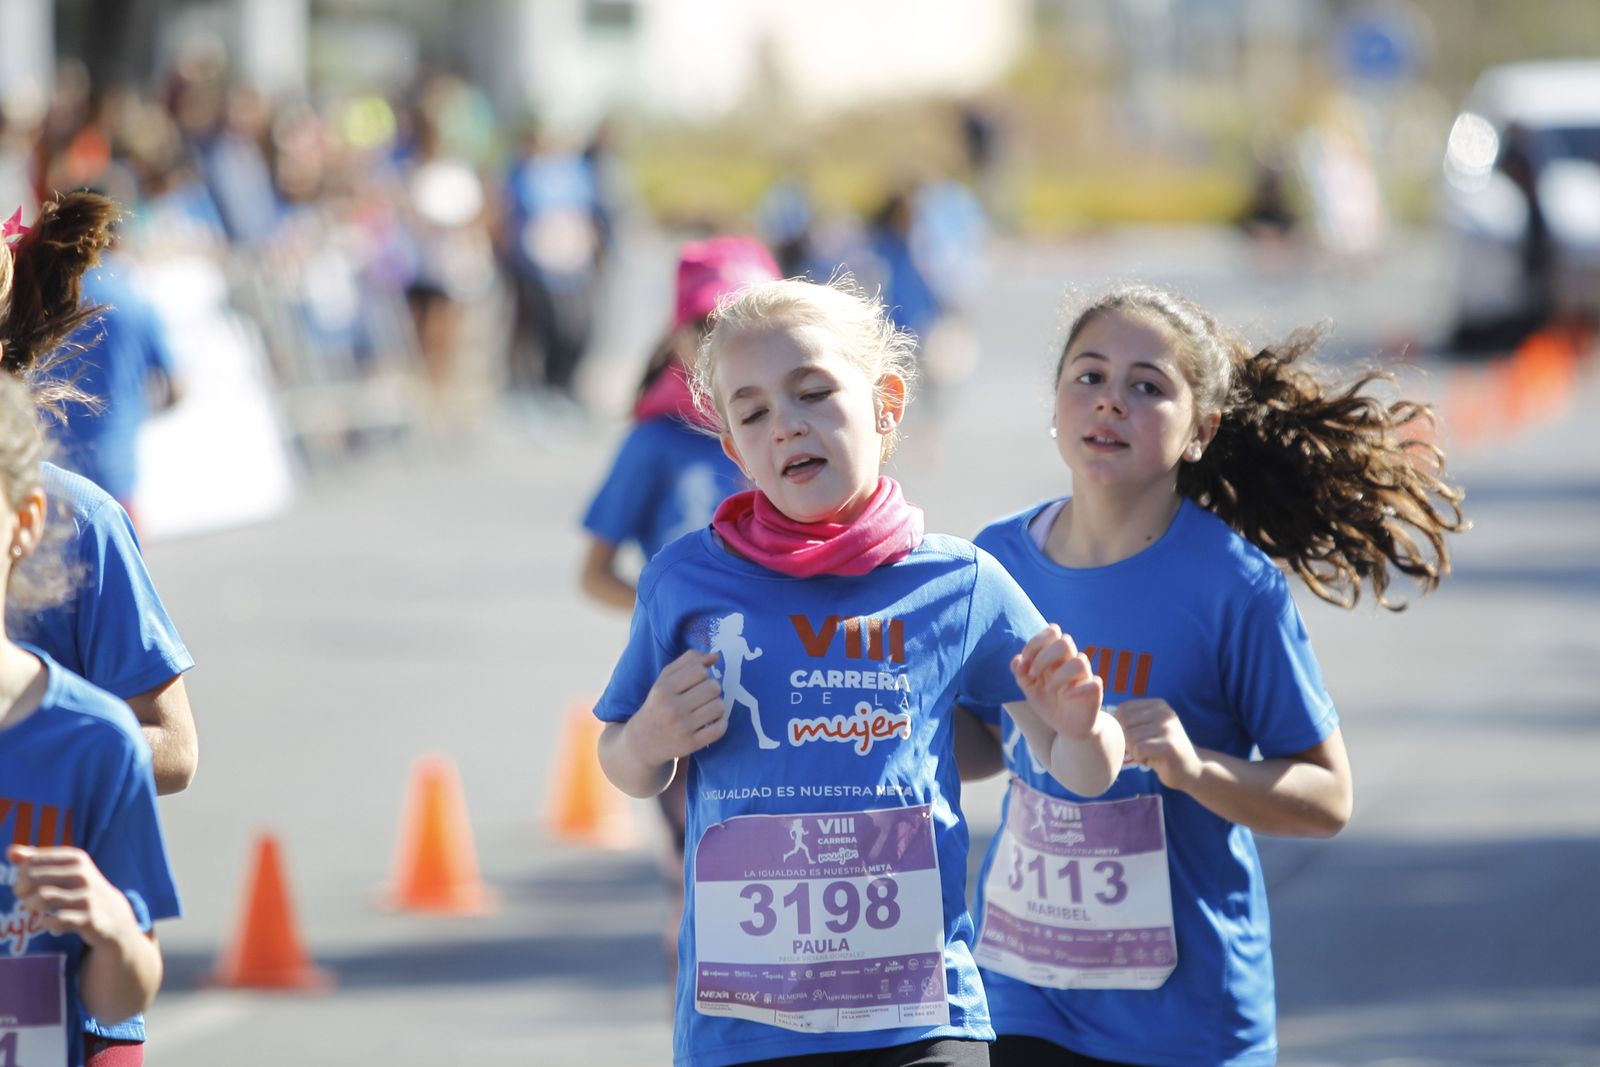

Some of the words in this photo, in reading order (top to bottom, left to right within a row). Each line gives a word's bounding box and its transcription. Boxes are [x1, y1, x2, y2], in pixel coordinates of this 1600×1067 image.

[789, 614, 905, 663] VIII
[1084, 645, 1152, 696] III
[790, 669, 911, 692] CARRERA
[789, 704, 911, 755] mujer
[777, 786, 795, 797] ES
[801, 785, 872, 797] NUESTRA
[876, 785, 913, 797] META
[1050, 803, 1081, 820] VIII
[817, 817, 856, 835] VIII
[817, 836, 857, 845] CARRERA
[818, 847, 859, 865] mujer
[758, 869, 807, 878] IGUALDAD
[809, 868, 821, 877] ES
[823, 866, 867, 878] NUESTRA
[868, 863, 893, 873] META
[1008, 846, 1129, 906] 3113
[739, 877, 901, 936] 3198
[1027, 901, 1091, 921] MARIBEL
[792, 937, 850, 954] PAULA
